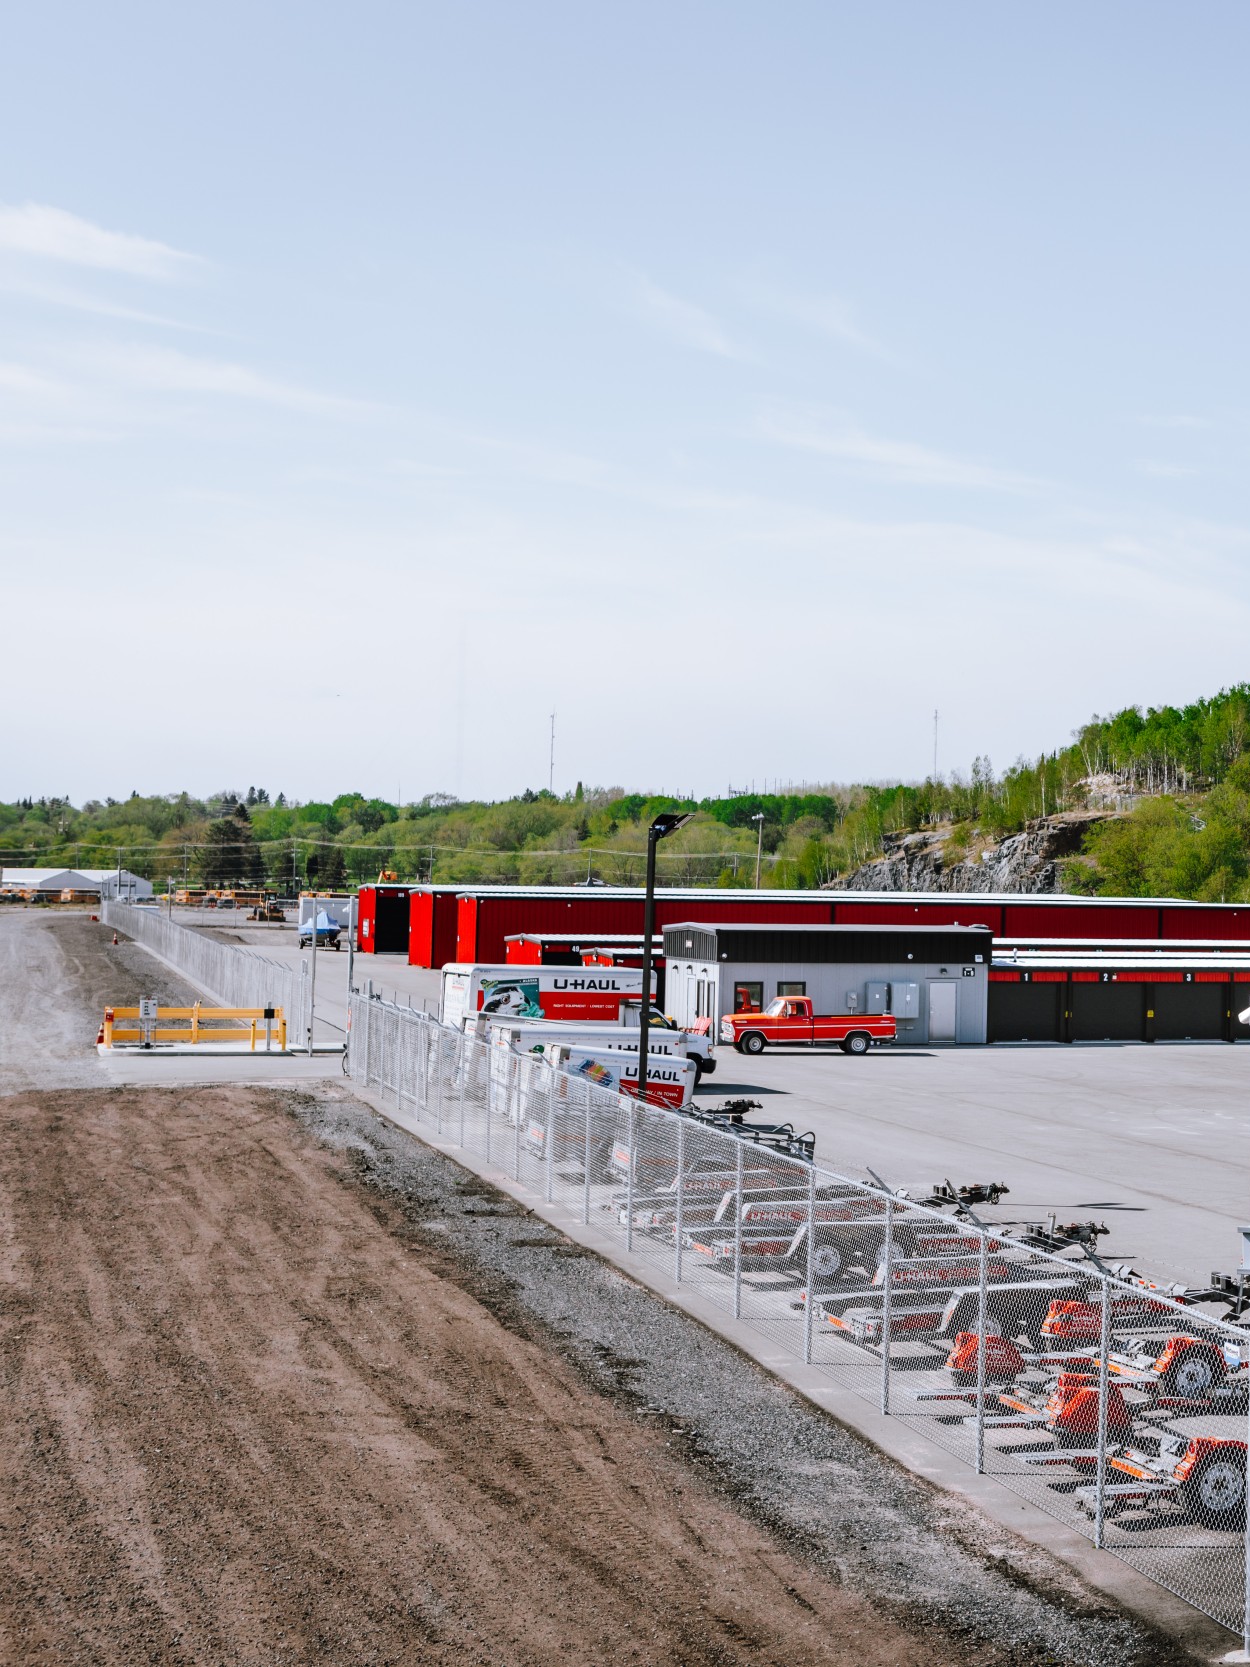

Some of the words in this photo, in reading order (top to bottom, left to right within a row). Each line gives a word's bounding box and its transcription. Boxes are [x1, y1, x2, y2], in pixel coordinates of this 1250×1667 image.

[1024, 973, 1029, 982] 1
[1103, 973, 1108, 982] 2
[1186, 973, 1191, 982] 3
[553, 978, 621, 991] U-HAUL
